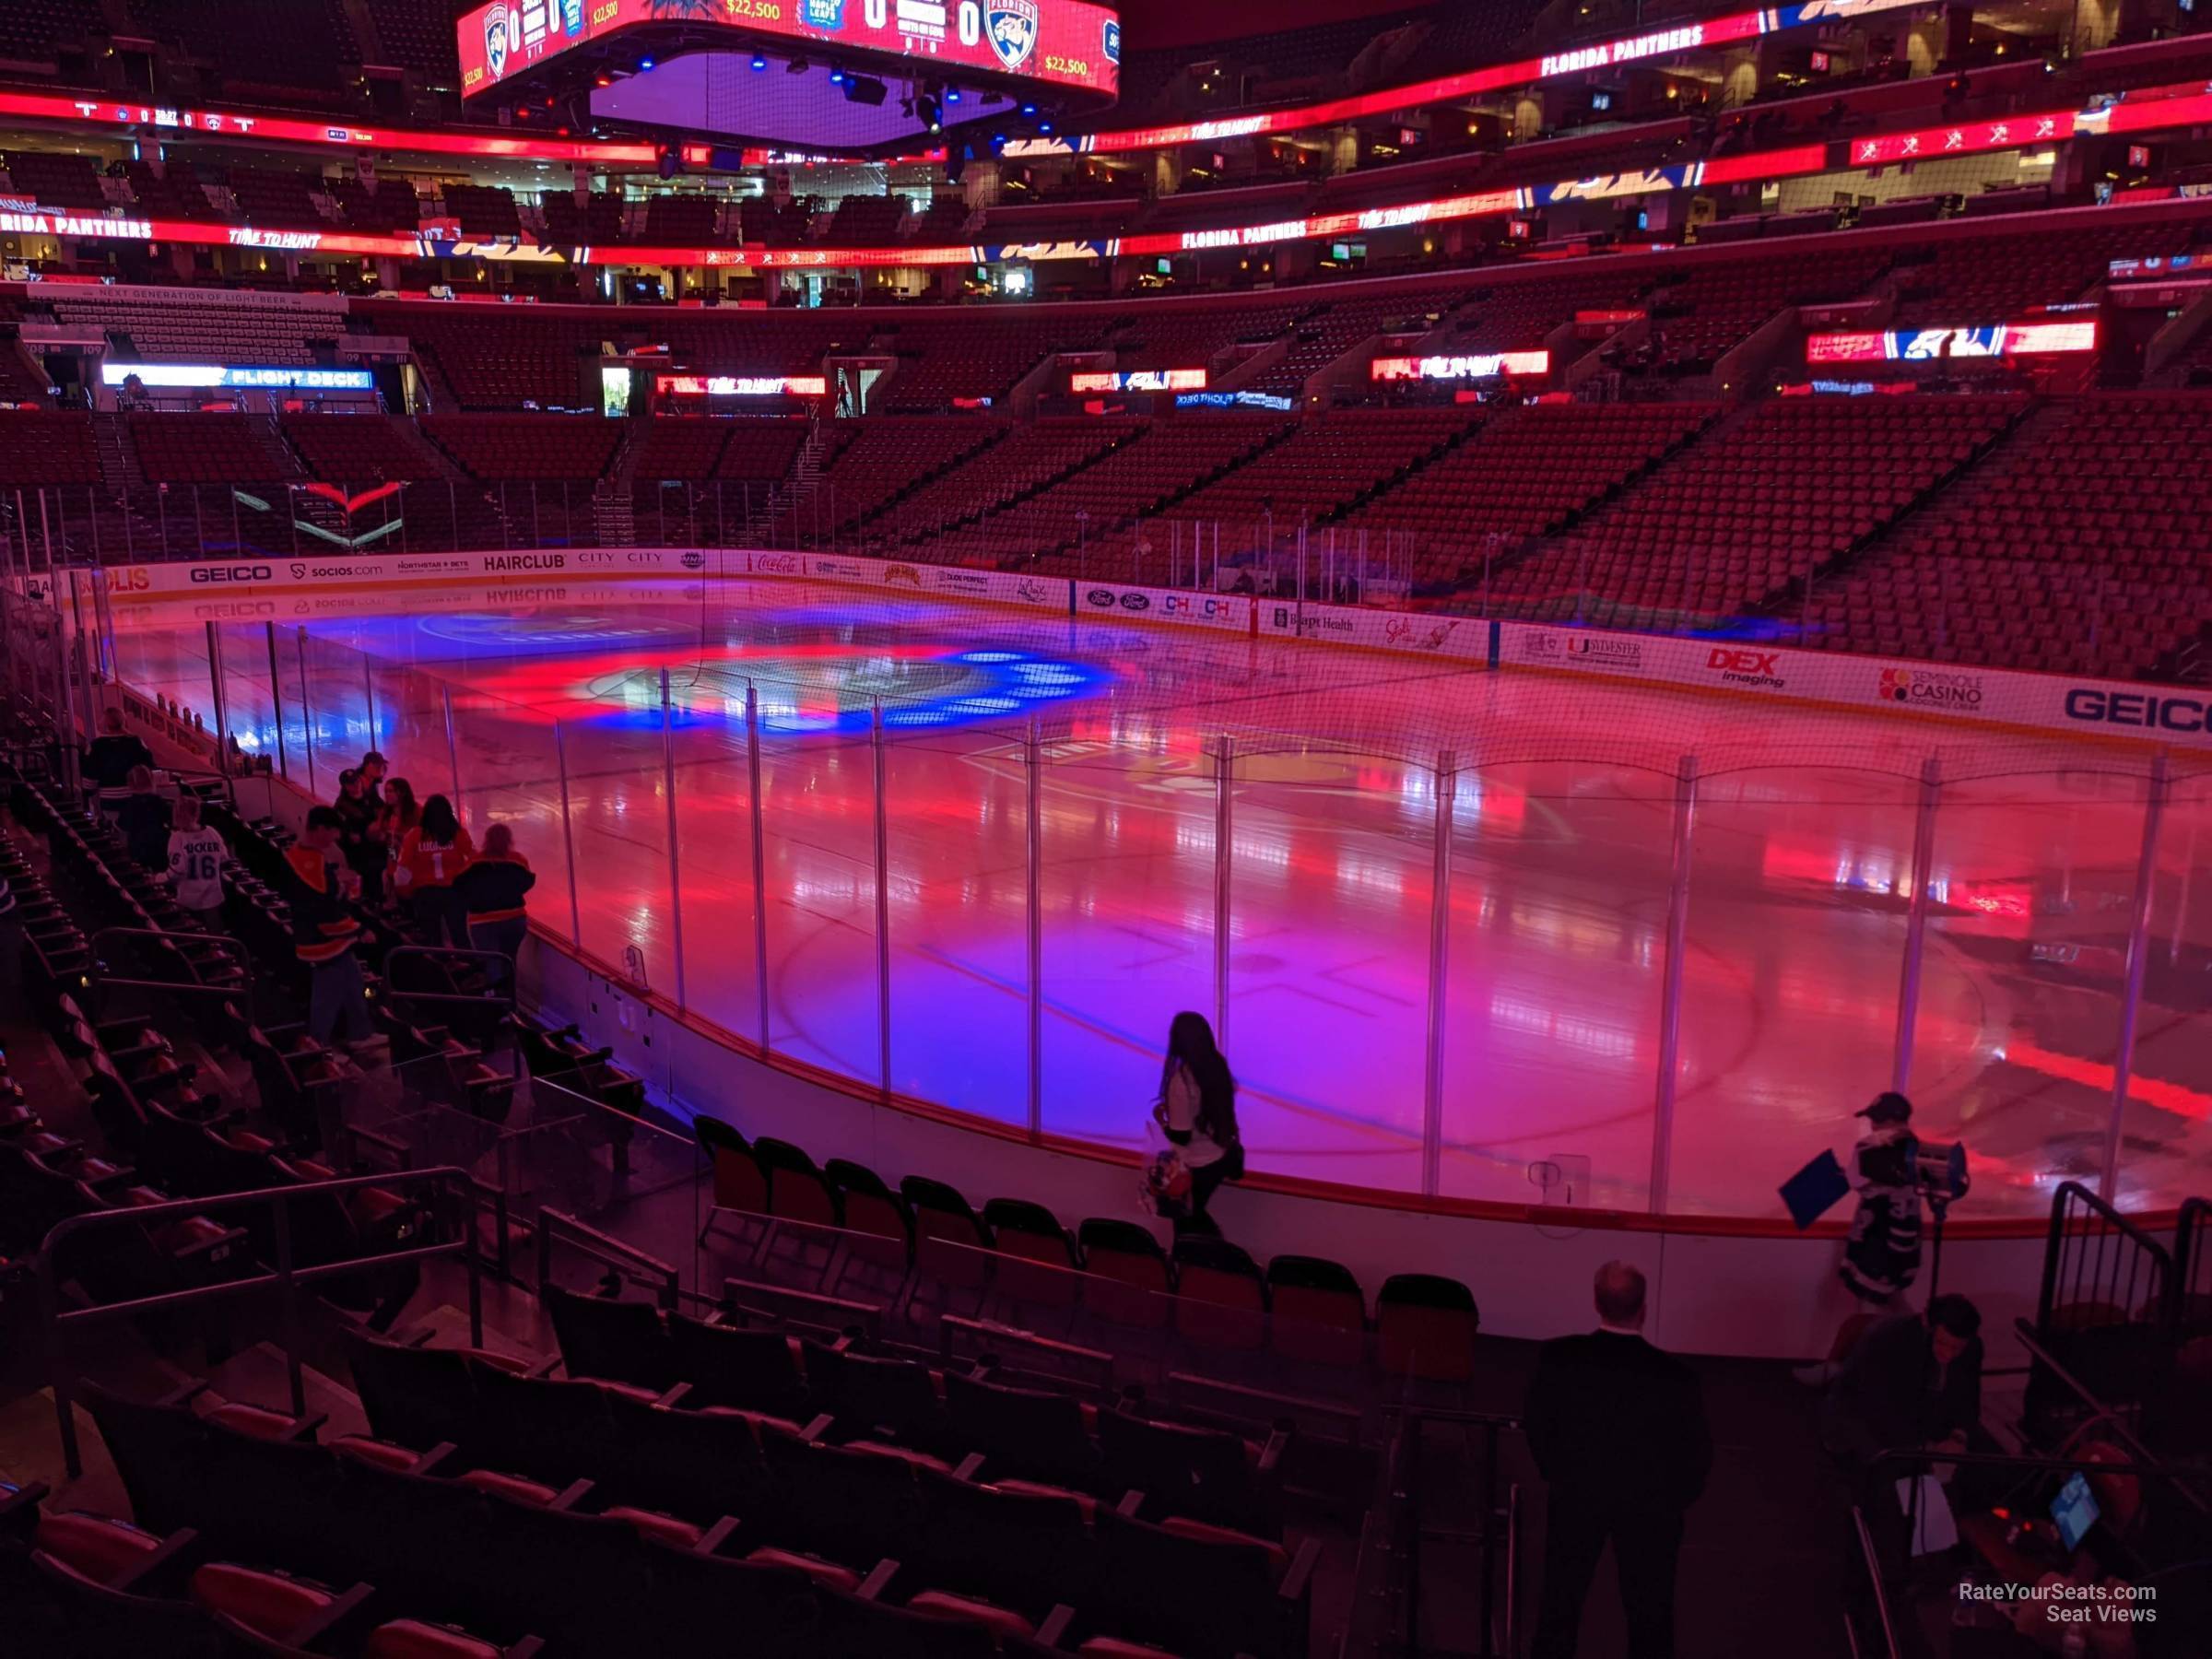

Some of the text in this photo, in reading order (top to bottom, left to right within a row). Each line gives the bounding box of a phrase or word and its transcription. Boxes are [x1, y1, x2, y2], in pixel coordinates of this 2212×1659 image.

[510, 10, 520, 53] 0
[959, 2, 979, 46] 0
[1541, 25, 1703, 76] FLORIDA PANTHERS
[1045, 55, 1088, 75] $22,500
[56, 217, 152, 239] PANTHERS
[1182, 221, 1306, 249] FLORIDA PANTHERS
[229, 229, 322, 249] TIME TO HUNT
[100, 288, 126, 298] NEXT
[132, 290, 204, 301] GENERATION
[225, 295, 255, 303] LIGHT
[259, 297, 287, 305] BEER
[83, 345, 102, 355] 109
[232, 371, 361, 386] FLIGHT DECK
[484, 555, 565, 571] HAIRCLUB
[579, 553, 615, 562] CITY
[628, 553, 662, 562] CITY
[191, 565, 272, 583] GEICO
[1090, 591, 1112, 606] Ford
[1124, 594, 1146, 609] Ford
[1324, 617, 1353, 631] Health
[1707, 648, 1781, 676] DEX
[1722, 671, 1784, 688] imaging
[1912, 670, 1983, 688] SEMINOLE
[1912, 683, 1982, 704] CASINO
[2065, 688, 2212, 734] GEIC
[184, 841, 220, 853] UCKER
[187, 854, 216, 880] 16
[432, 852, 444, 880] 1
